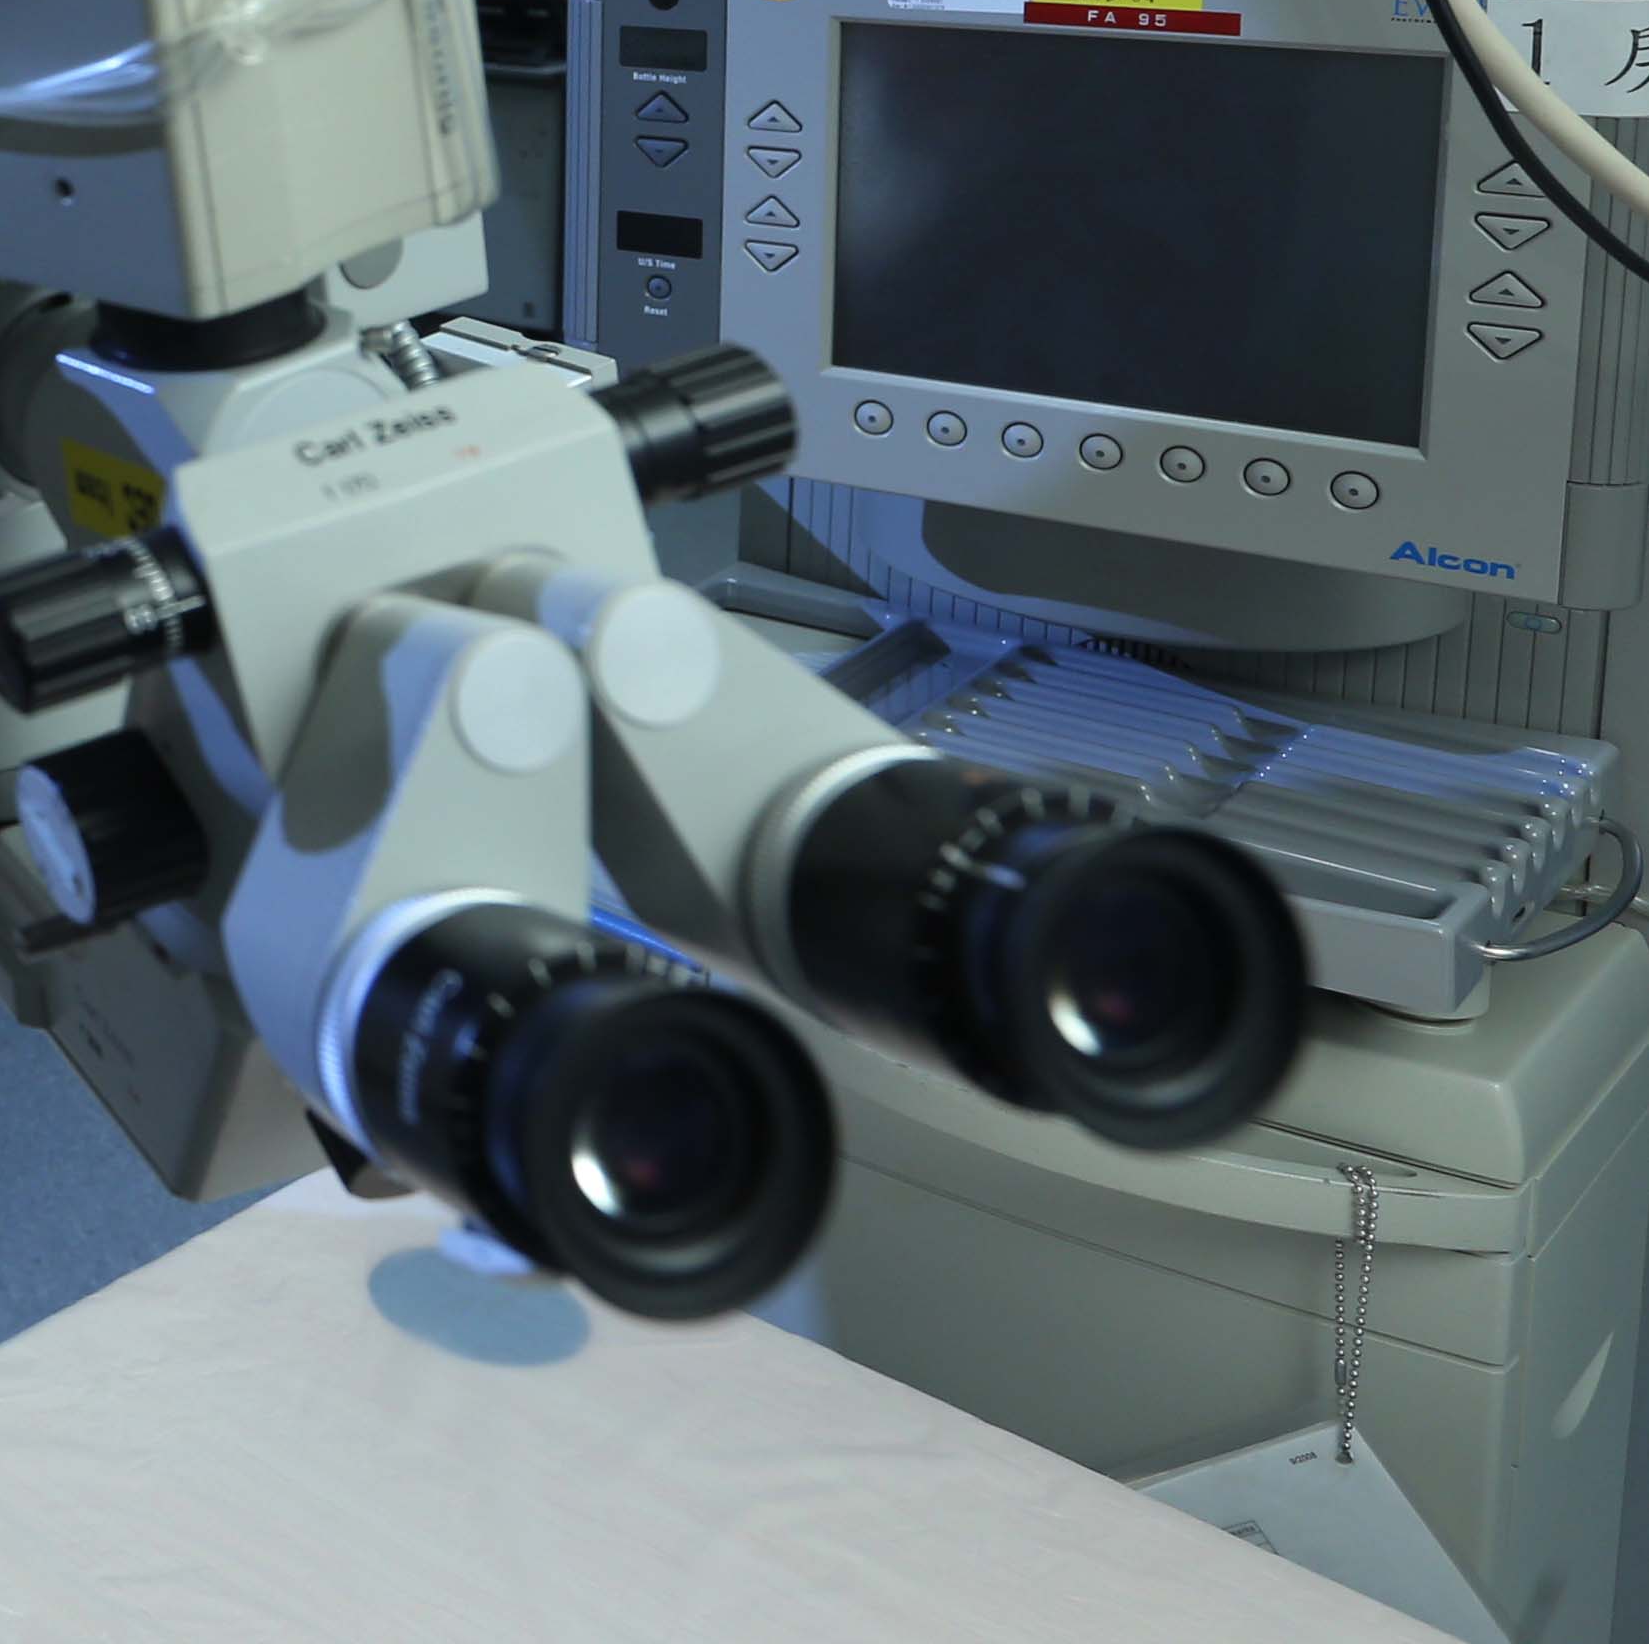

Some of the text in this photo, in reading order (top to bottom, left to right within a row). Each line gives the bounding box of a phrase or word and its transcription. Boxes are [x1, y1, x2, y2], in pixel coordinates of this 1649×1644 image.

[1087, 9, 1168, 28] FA 95
[655, 258, 676, 270] Time
[643, 305, 668, 317] Reset
[293, 406, 457, 466] Carl Zeiss
[1389, 540, 1516, 581] Alcon
